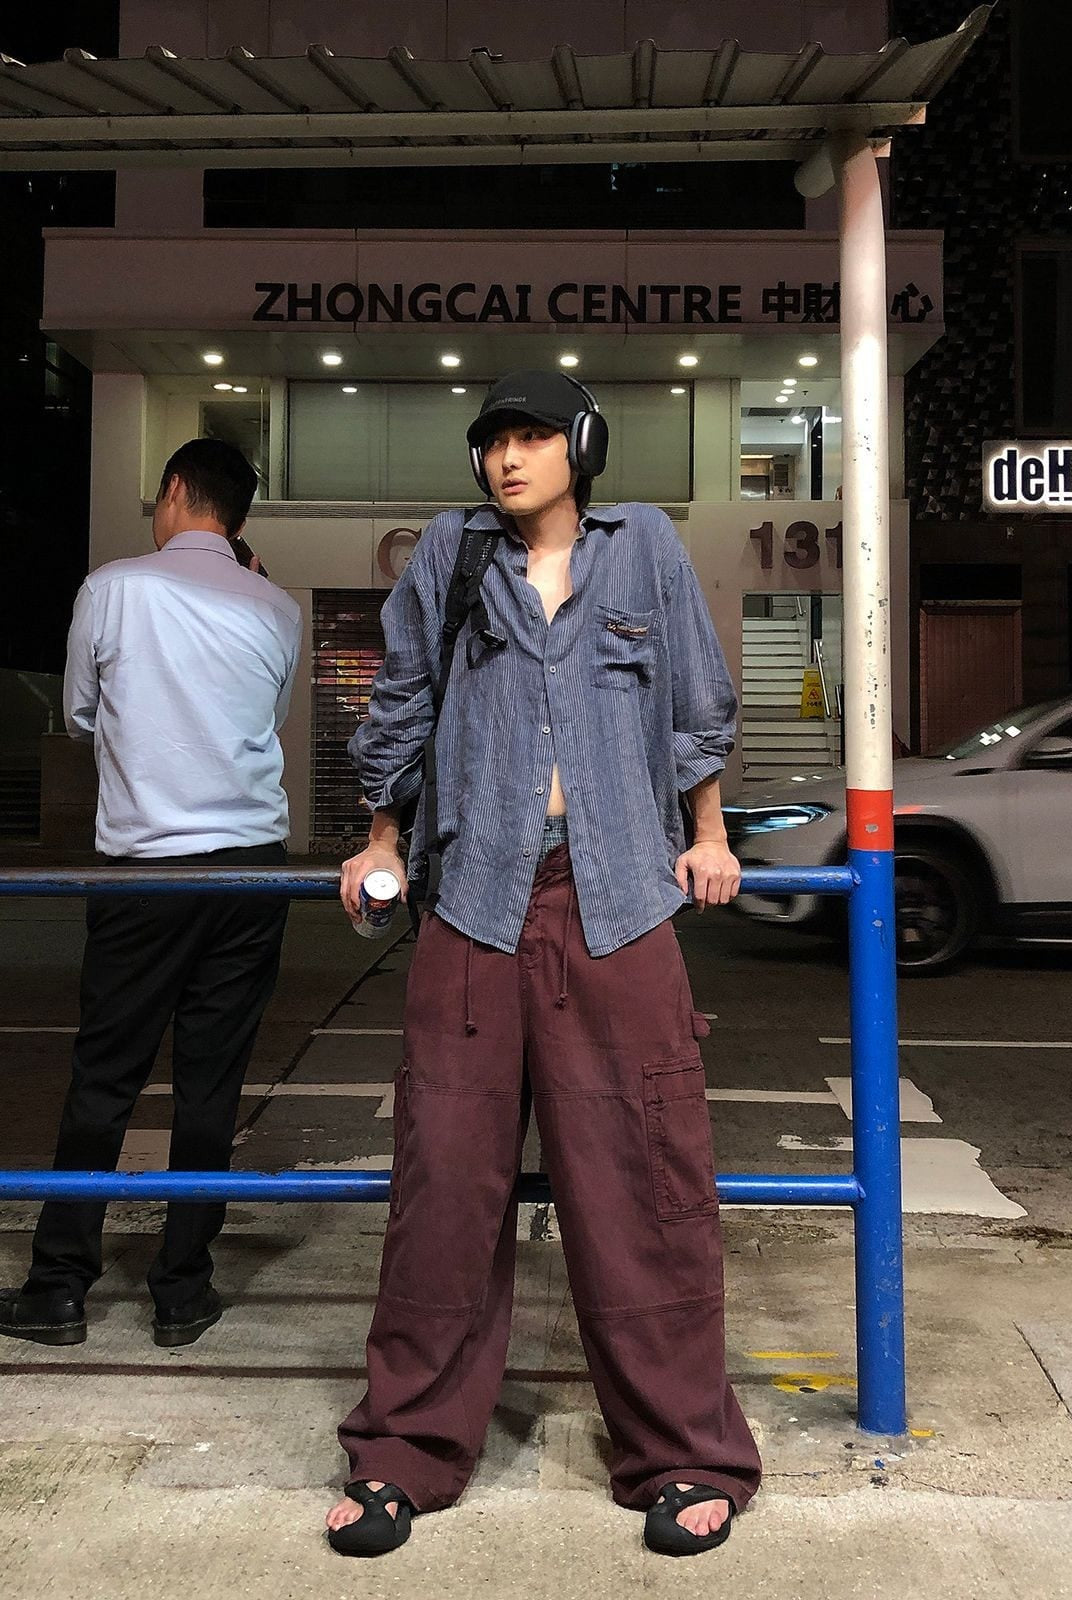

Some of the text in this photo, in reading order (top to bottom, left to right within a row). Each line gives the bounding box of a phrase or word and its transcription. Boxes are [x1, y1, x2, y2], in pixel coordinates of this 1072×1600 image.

[252, 283, 742, 322] ZHONGCAI CENTRE
[762, 281, 934, 322] 中財心
